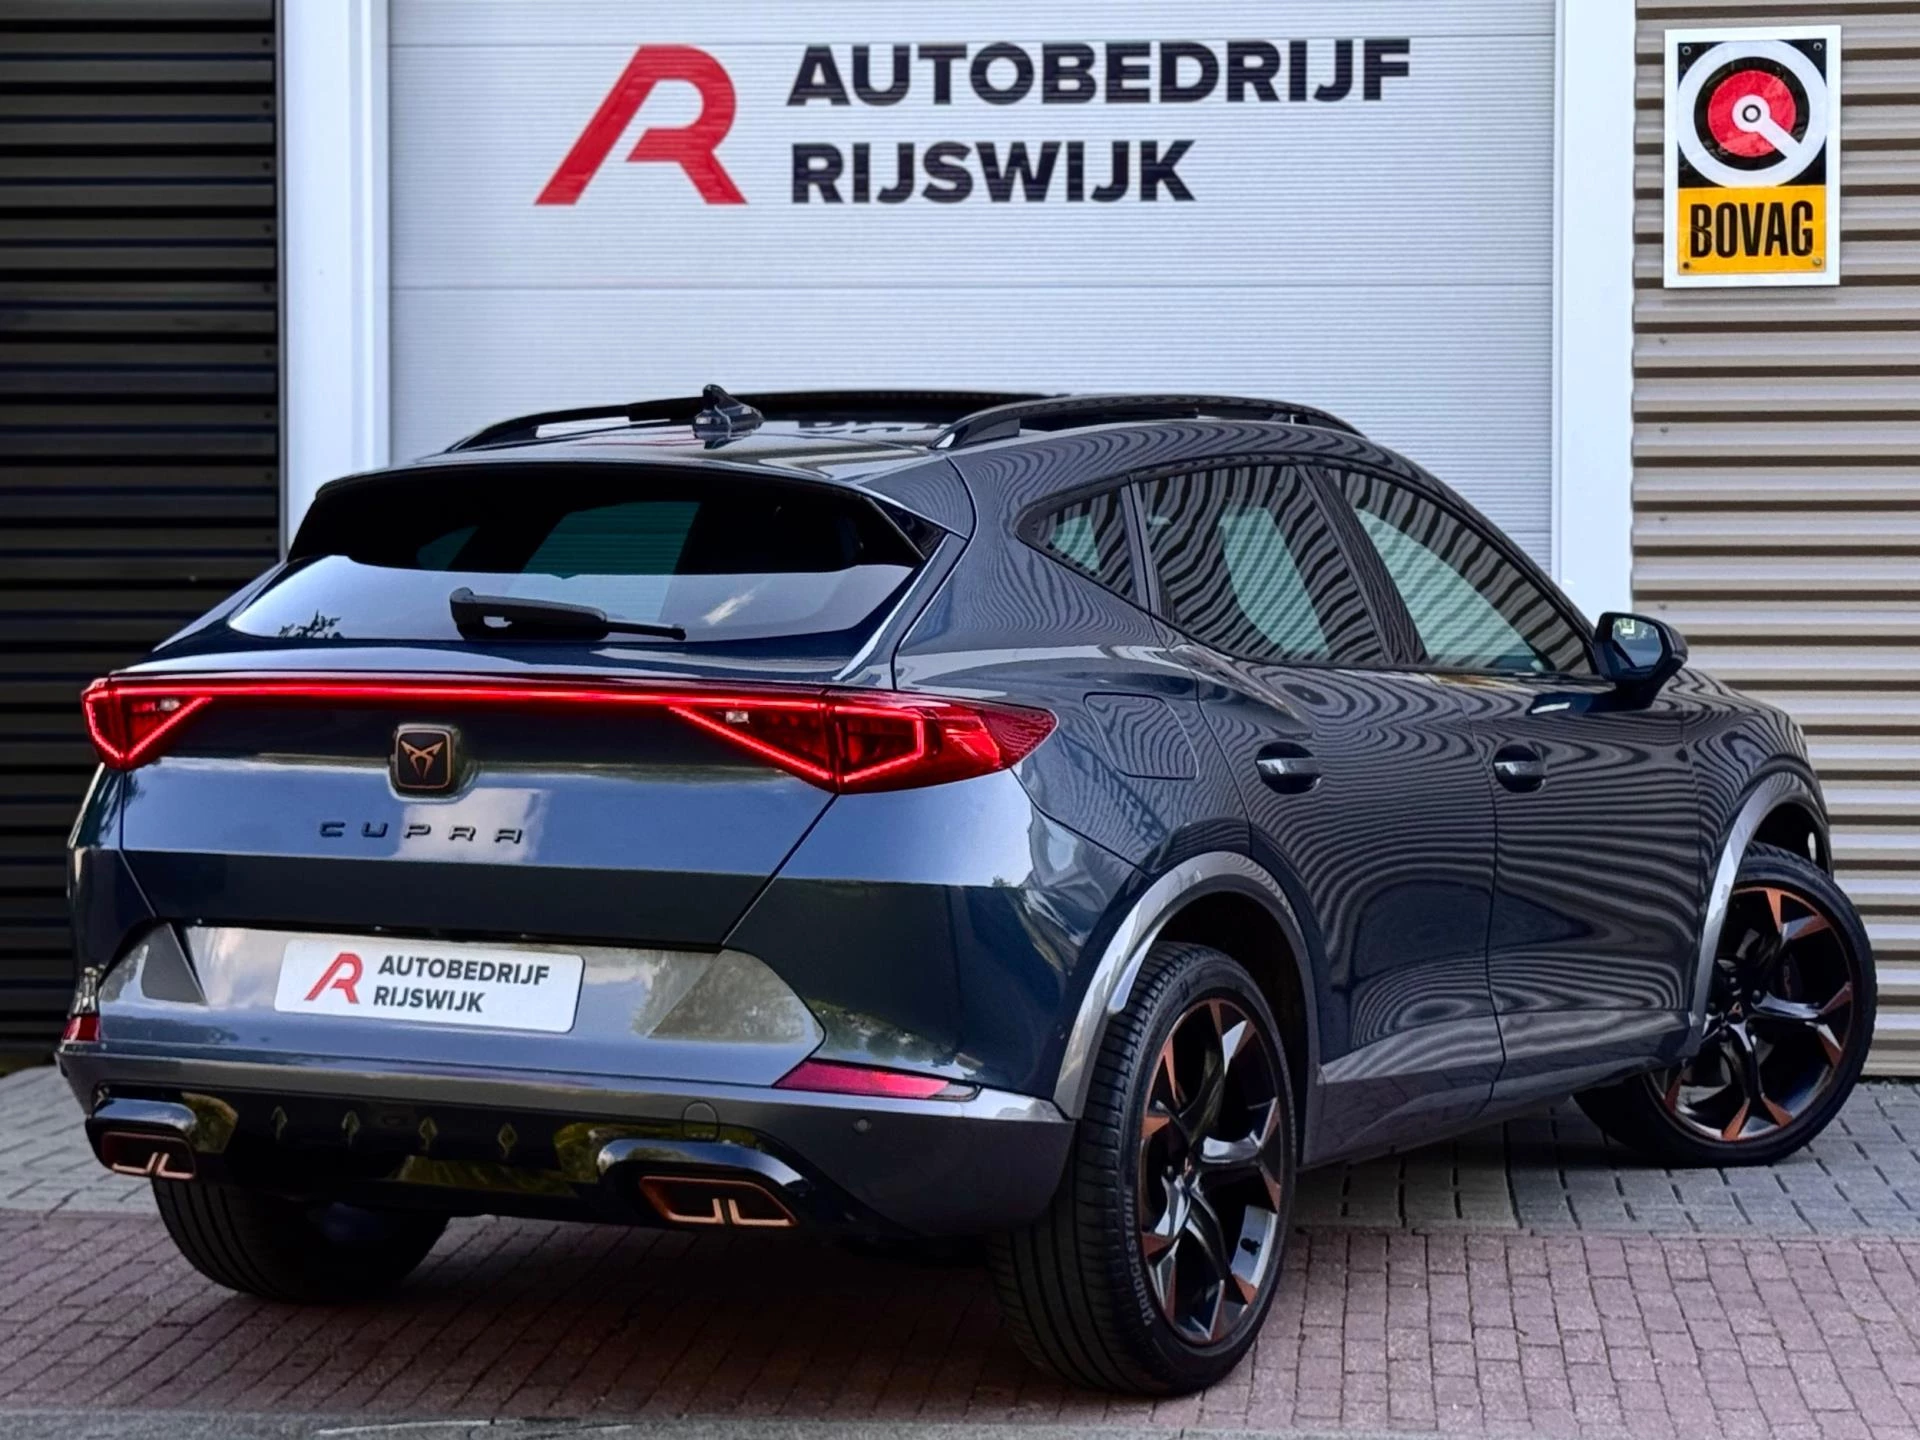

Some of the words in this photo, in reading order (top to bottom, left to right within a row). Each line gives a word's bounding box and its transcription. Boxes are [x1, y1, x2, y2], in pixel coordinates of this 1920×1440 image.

[788, 37, 1410, 106] AUTOBEDRIJF
[792, 140, 1195, 204] RIJSWIJK
[1690, 201, 1814, 259] BOVAG
[320, 821, 524, 844] CUPRA
[378, 955, 549, 985] AUTOBEDRIJF
[373, 986, 484, 1012] RIJSWIJK
